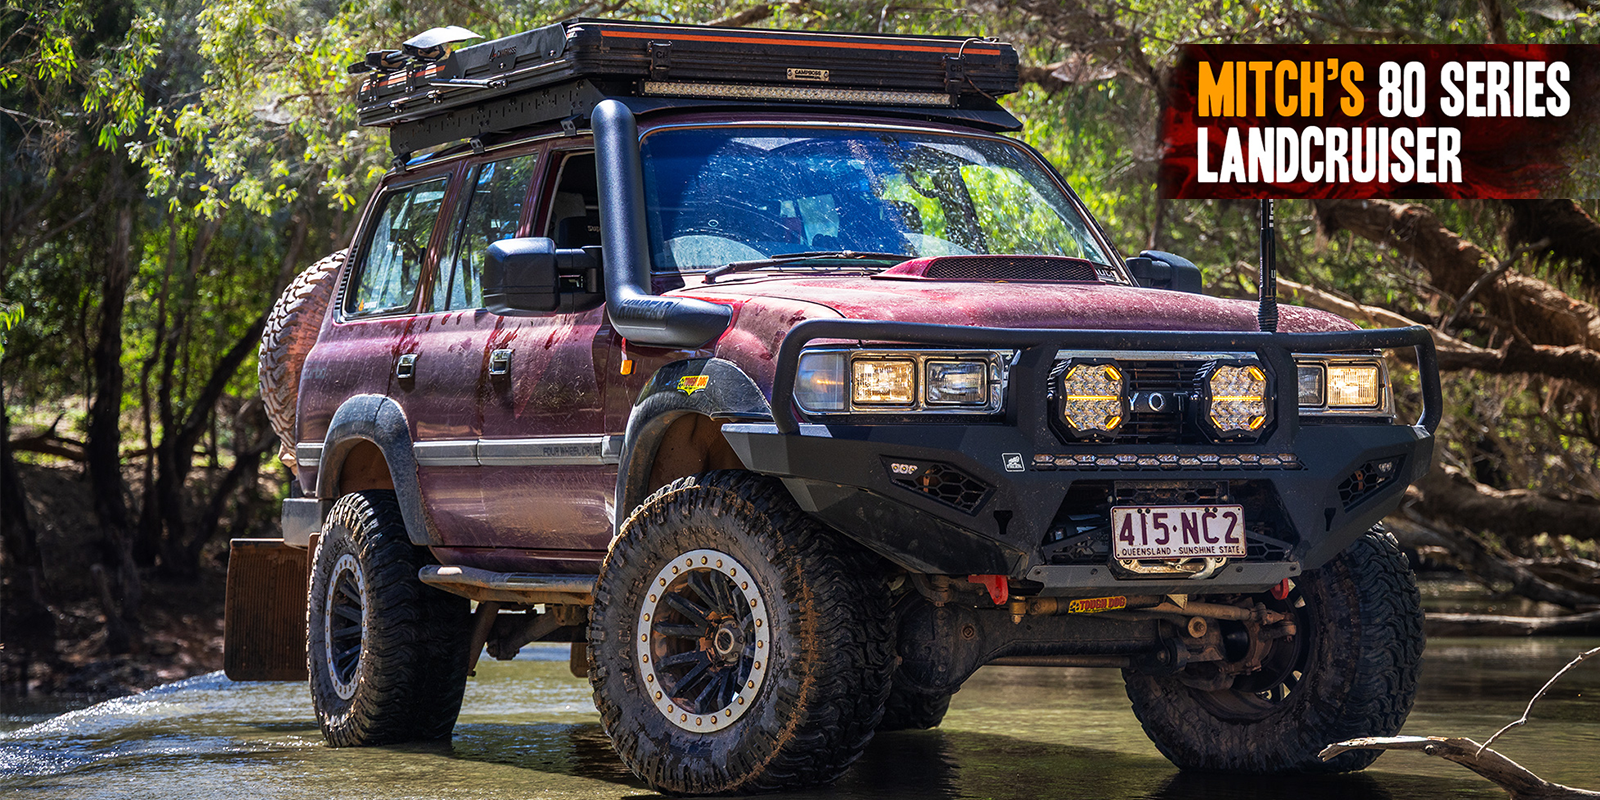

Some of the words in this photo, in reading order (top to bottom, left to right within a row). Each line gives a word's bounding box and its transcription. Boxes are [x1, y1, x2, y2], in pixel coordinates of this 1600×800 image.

[1127, 391, 1189, 412] YOT
[543, 447, 559, 457] FOUR
[560, 446, 581, 456] WHEEL
[1121, 547, 1172, 556] QUEENSLAND
[1178, 545, 1216, 555] SUNSHINE
[1218, 545, 1240, 554] STATE
[1079, 598, 1108, 611] TOUGH
[1107, 596, 1126, 609] DOG
